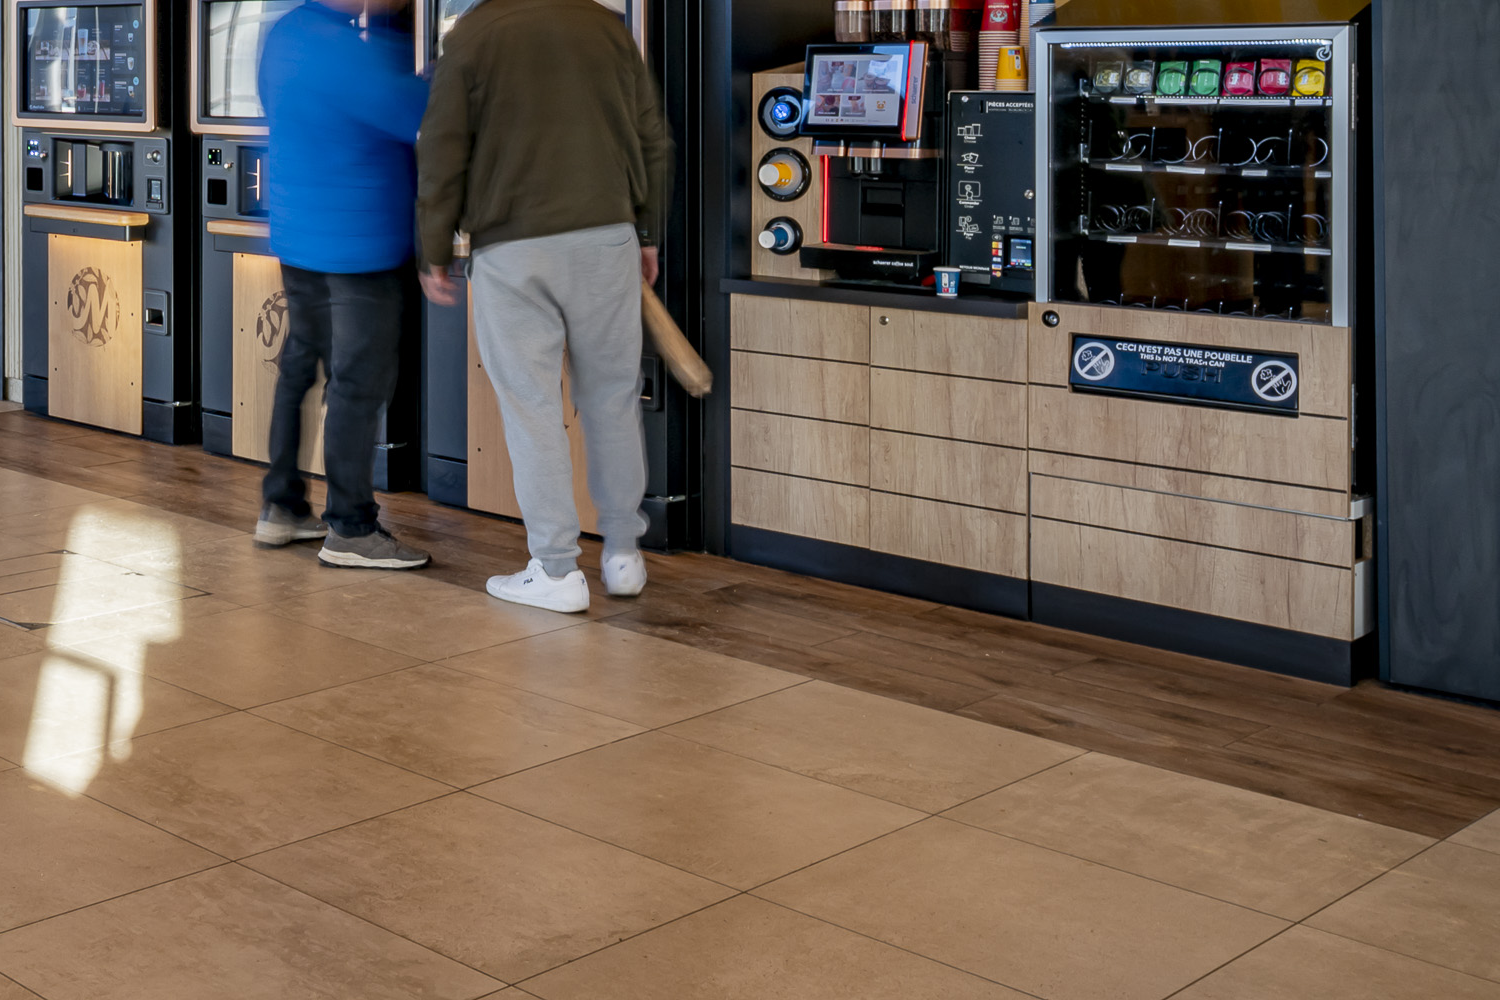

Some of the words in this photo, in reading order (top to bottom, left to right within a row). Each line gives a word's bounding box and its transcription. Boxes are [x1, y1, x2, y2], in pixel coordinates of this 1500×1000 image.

[1116, 342, 1137, 352] CECI
[1138, 344, 1163, 354] N'EST
[1164, 347, 1182, 357] PAS
[1183, 349, 1203, 359] UNE
[1204, 351, 1252, 364] POUBELLE
[1140, 353, 1154, 361] THIS
[1162, 355, 1177, 363] NOT
[1208, 360, 1225, 368] CAN
[1141, 361, 1222, 384] PUSH
